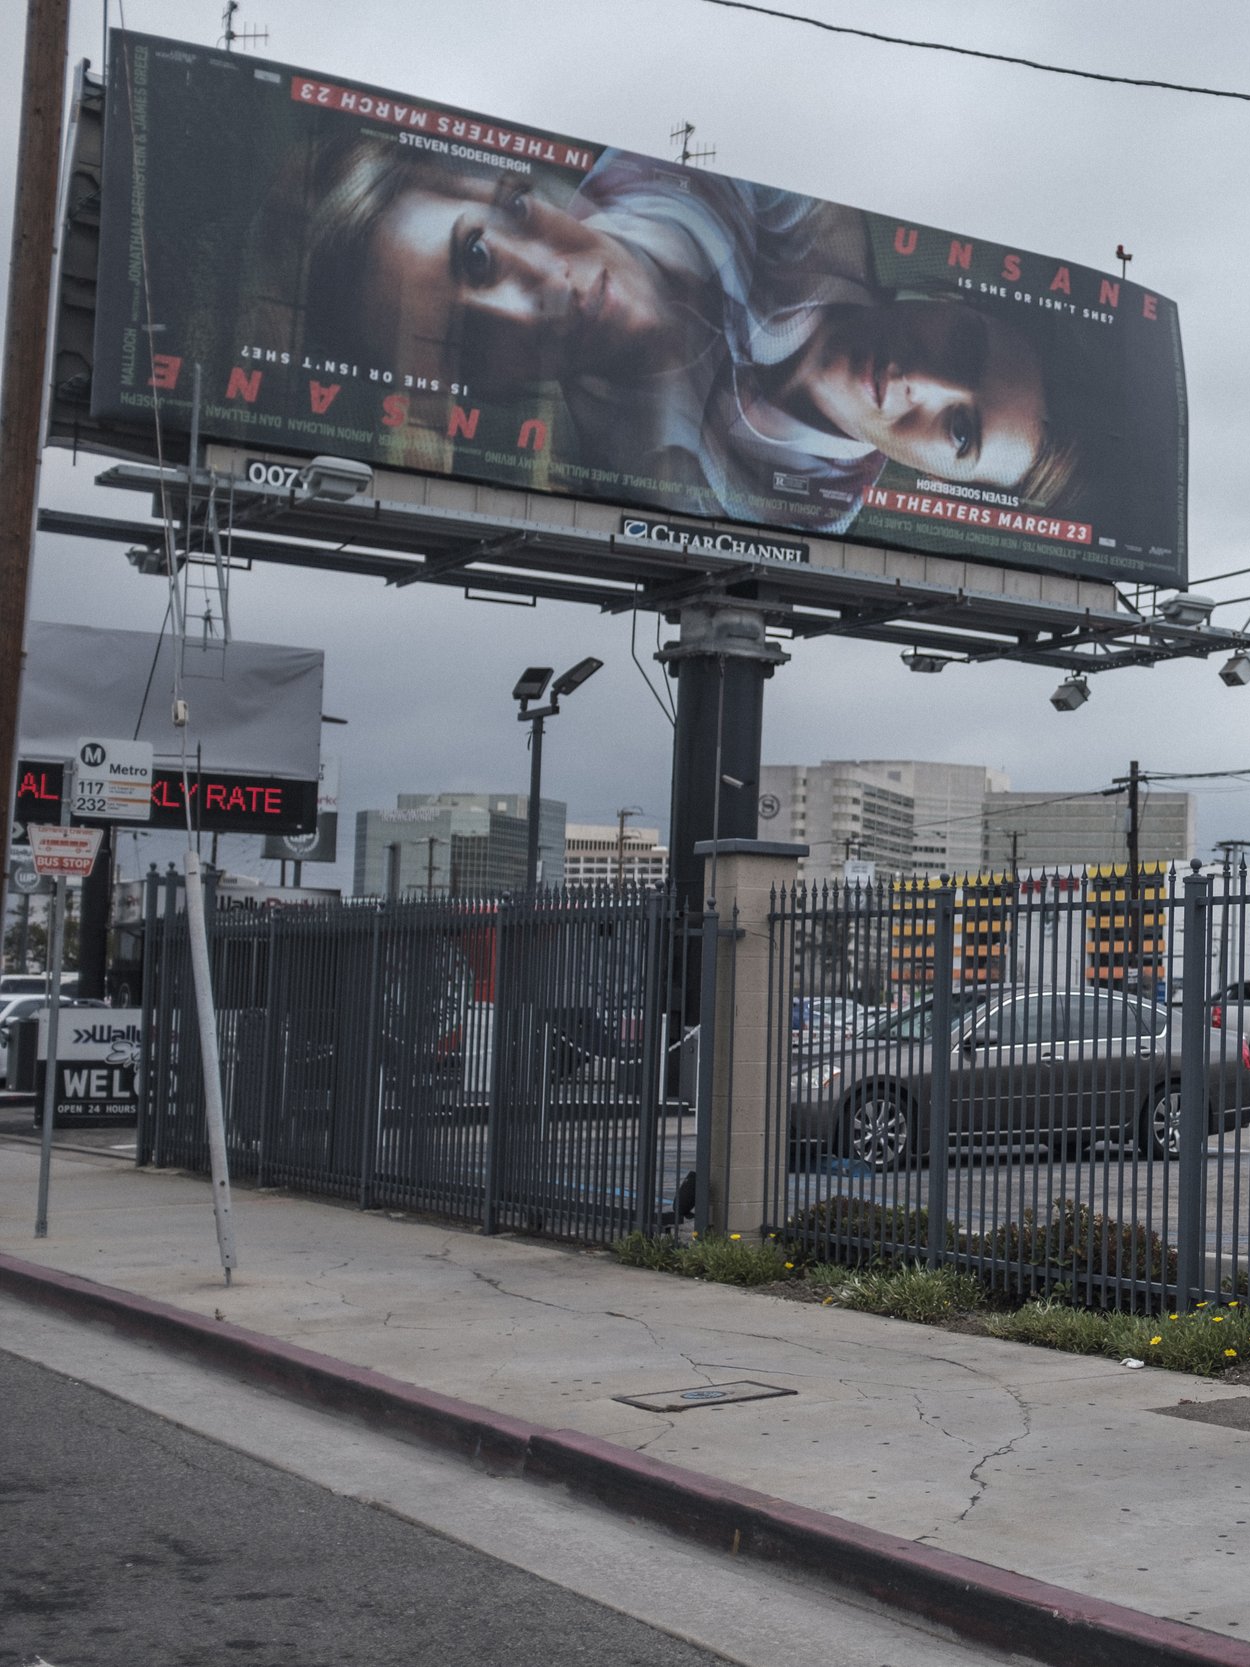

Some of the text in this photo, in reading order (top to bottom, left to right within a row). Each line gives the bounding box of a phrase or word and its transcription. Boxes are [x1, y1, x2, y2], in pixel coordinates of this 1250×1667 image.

[300, 82, 328, 104] 23
[133, 87, 147, 130] JAMES
[340, 90, 427, 127] MARCH
[437, 116, 556, 160] THEATERS
[399, 131, 449, 153] STEVEN
[450, 144, 531, 174] SODERBERGH
[566, 147, 588, 168] IN
[128, 217, 144, 286] JONATHAN
[958, 277, 1115, 325] IS SHE OR ISN'T SHE?
[120, 327, 137, 386] MALLOCH
[240, 344, 468, 395] IS SHE OR ISN'T SHE?
[204, 404, 257, 424] FELLMAN
[258, 412, 283, 428] DAN
[249, 461, 308, 490] 007
[590, 469, 619, 483] AIMEE
[622, 474, 657, 489] TEMPLE
[916, 478, 981, 500] SODERBERGH
[981, 490, 1019, 507] STEVEN
[867, 489, 888, 507] IN
[895, 494, 991, 526] THEATERS
[998, 513, 1061, 537] MARCH
[1067, 523, 1088, 541] 23
[109, 763, 148, 777] Metro
[78, 780, 104, 795] 117
[76, 797, 106, 812] 232
[206, 784, 283, 814] RATE
[37, 856, 90, 869] BUS STOP
[57, 1104, 136, 1114] OPEN 24 HOURS
